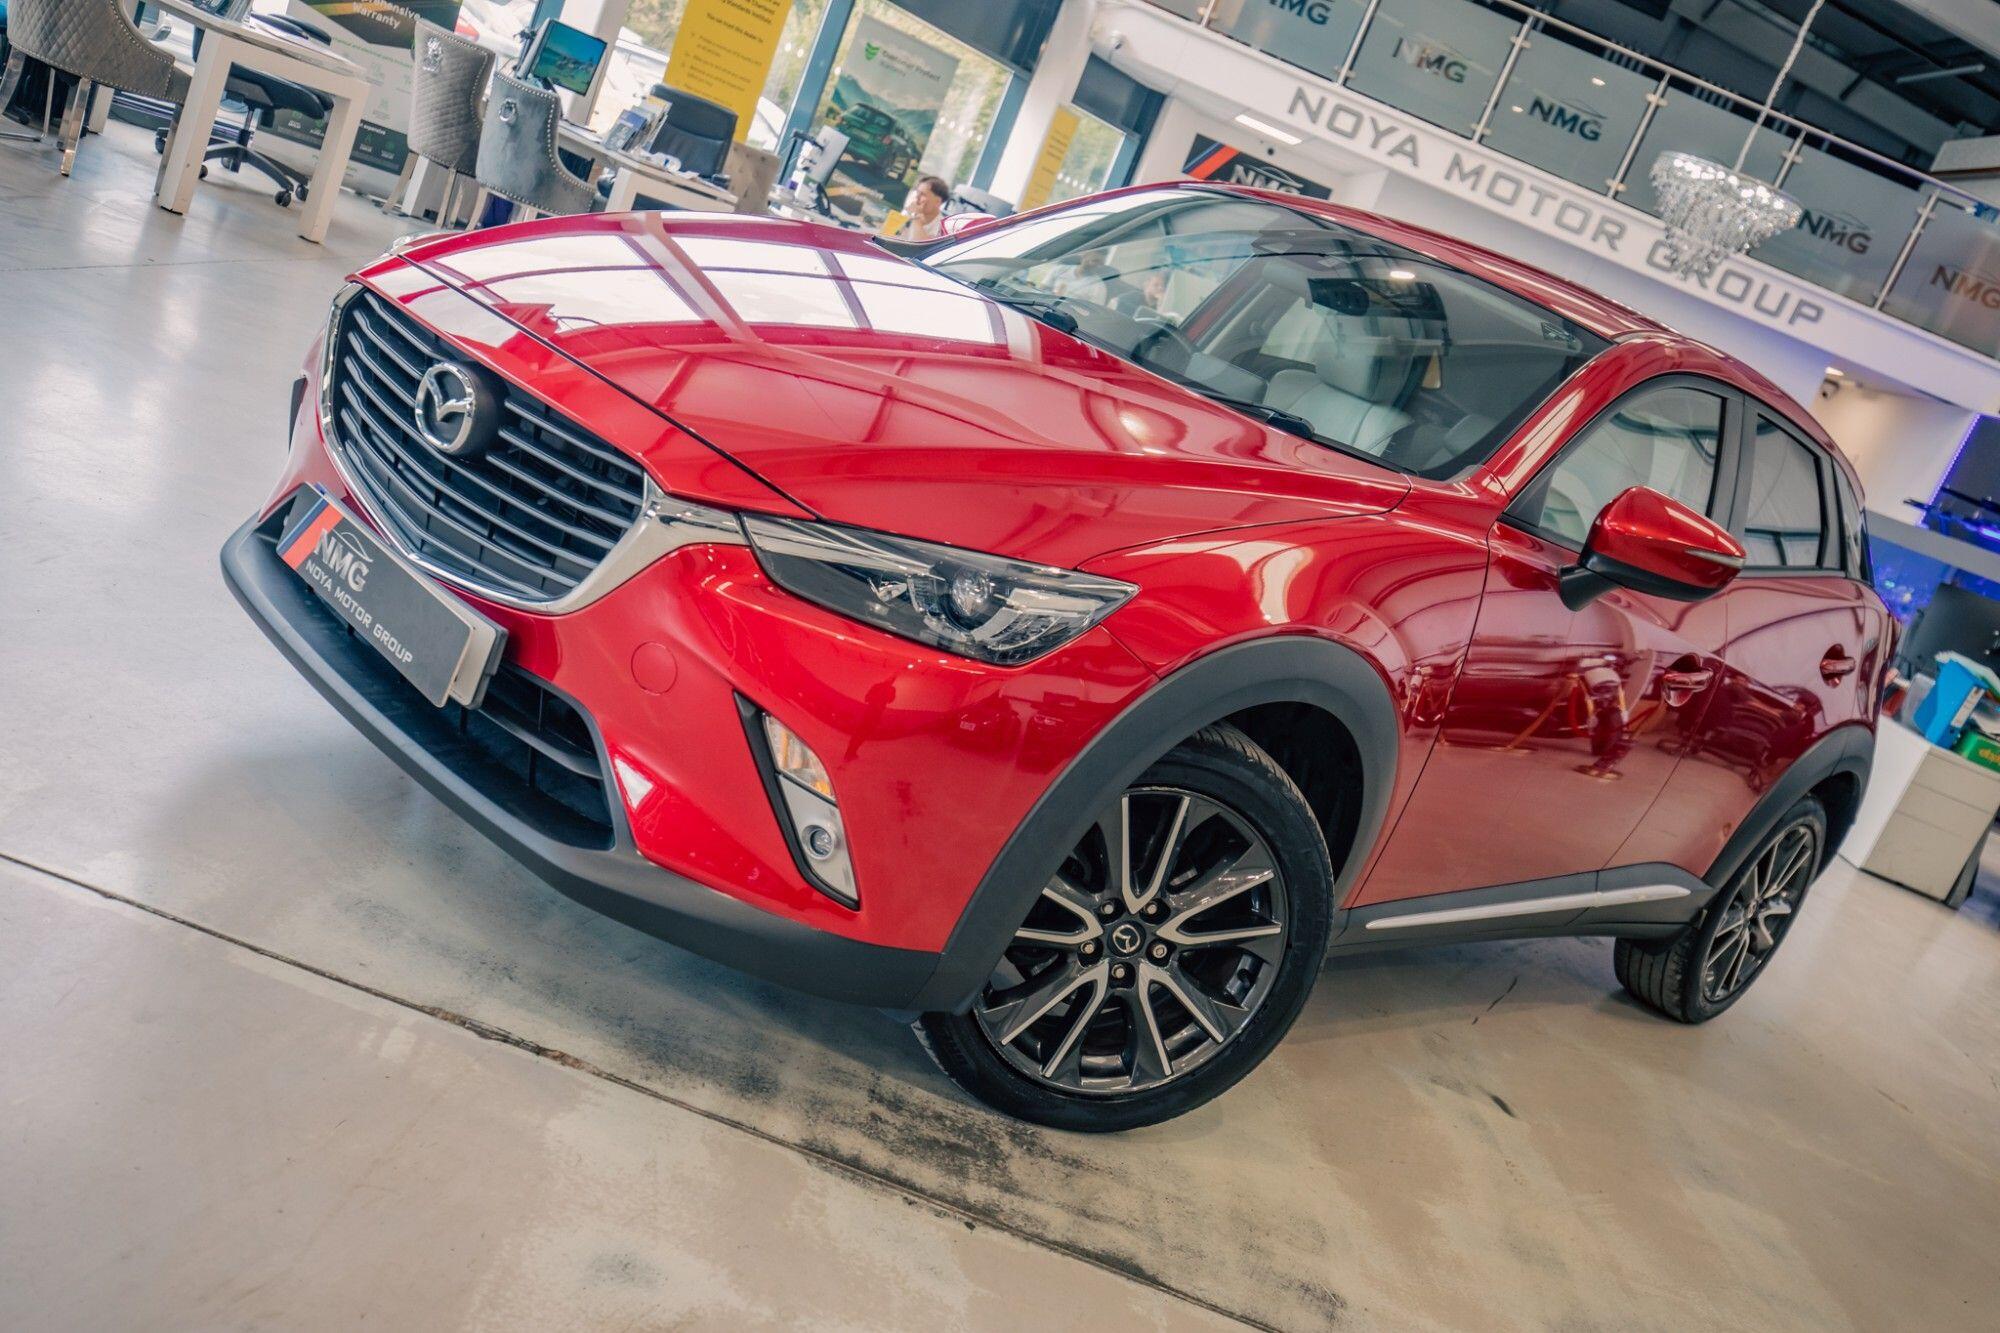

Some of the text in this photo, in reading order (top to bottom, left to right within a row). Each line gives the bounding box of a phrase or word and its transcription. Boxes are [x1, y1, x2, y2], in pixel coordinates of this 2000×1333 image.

[1392, 36, 1469, 83] NMG
[1528, 96, 1603, 142] NMG
[1287, 86, 1825, 326] NOYA MOTOR GROUP
[1796, 208, 1873, 255] NMG
[1930, 264, 2000, 310] NMG
[313, 527, 370, 593] NMG
[305, 560, 413, 664] NOYA MOTOR GROUP
